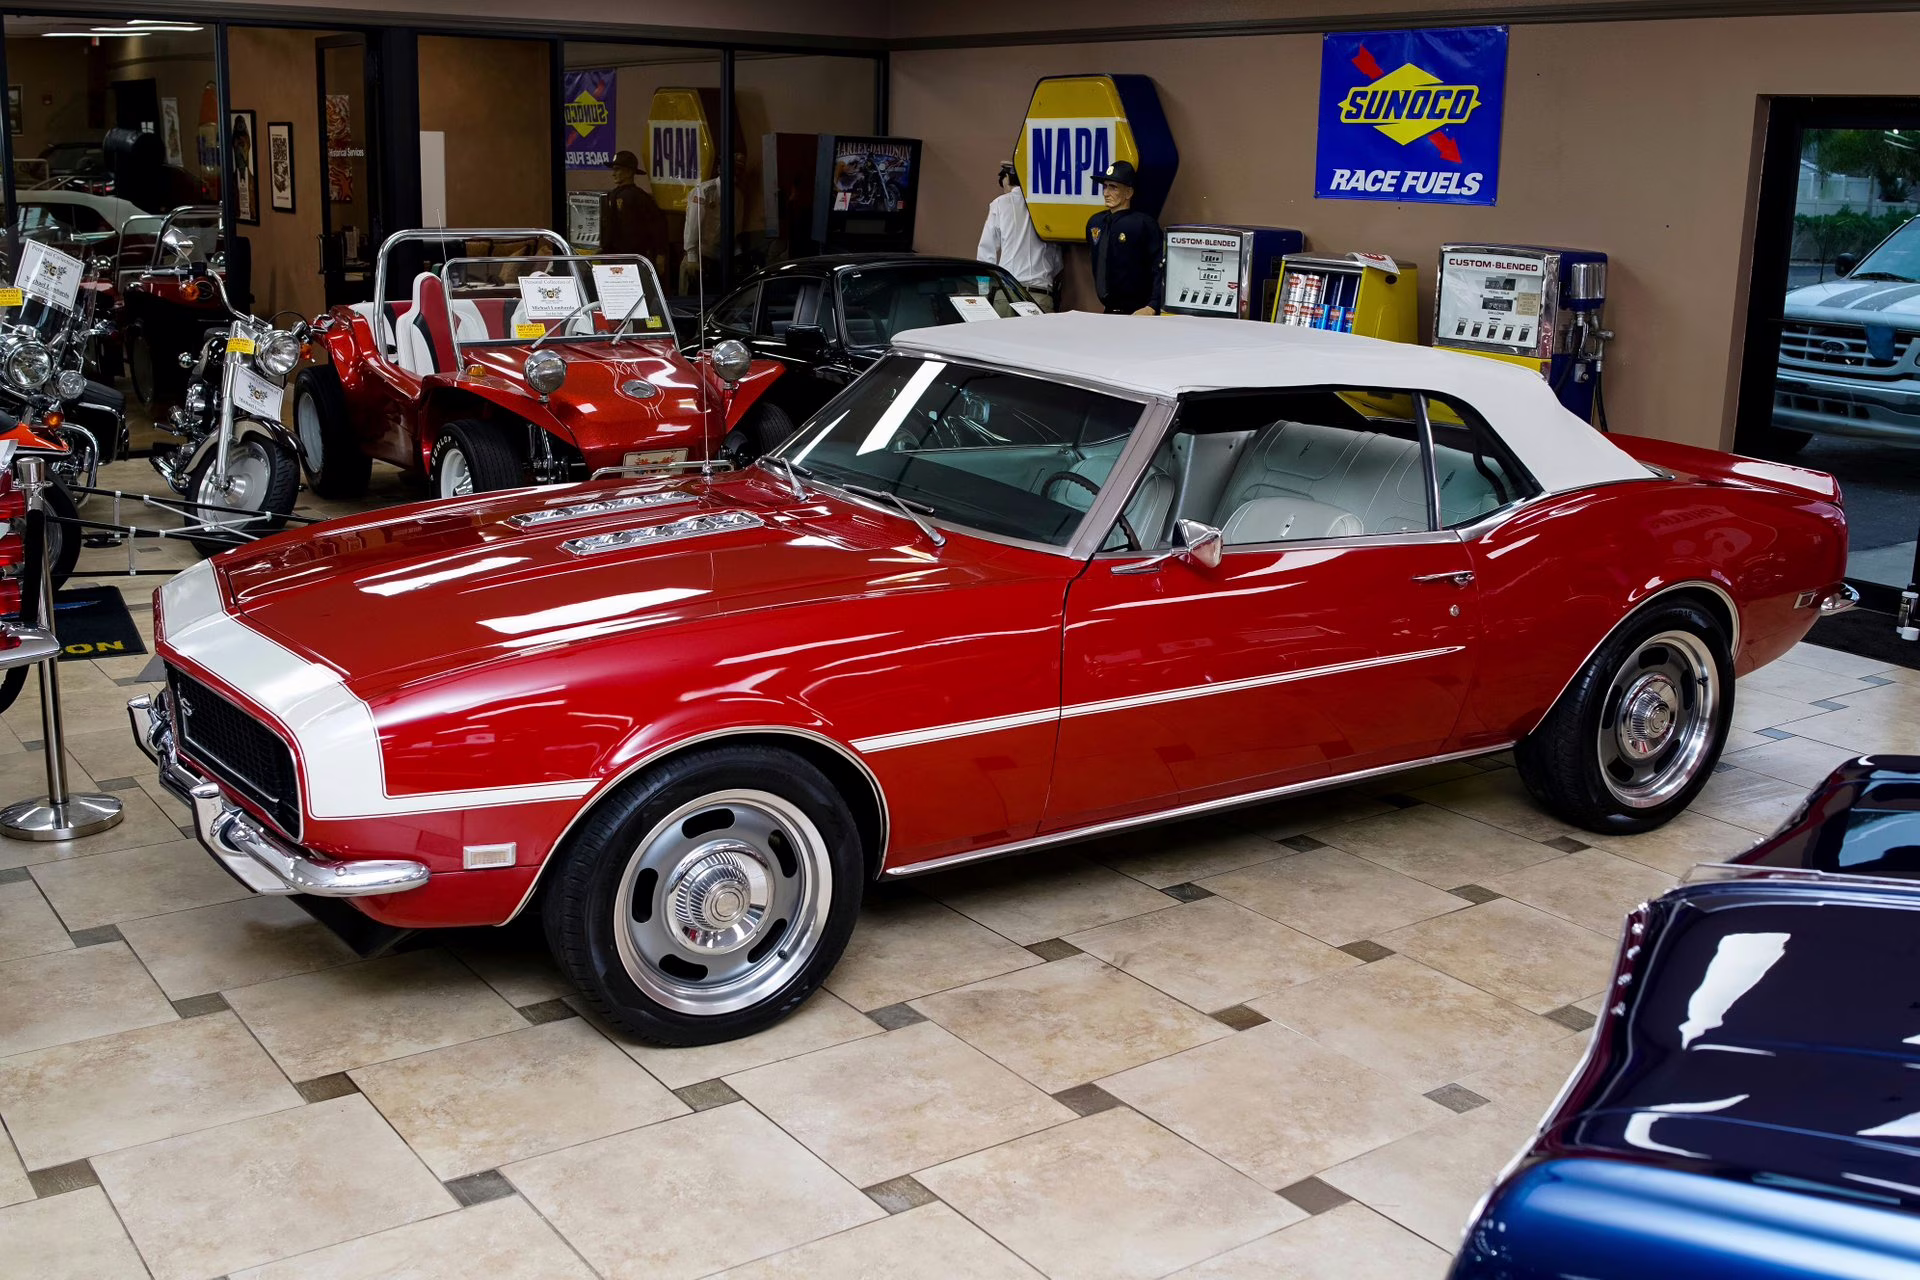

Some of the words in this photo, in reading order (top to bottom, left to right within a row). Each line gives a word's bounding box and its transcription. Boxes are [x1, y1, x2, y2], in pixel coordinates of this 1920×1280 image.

[1344, 89, 1475, 120] SUNOCO
[347, 147, 365, 157] Services
[1032, 127, 1110, 196] NAPA
[1329, 168, 1401, 192] RACE
[1401, 170, 1484, 196] FUELS
[431, 435, 452, 466] DUNLOP
[65, 640, 125, 654] ON
